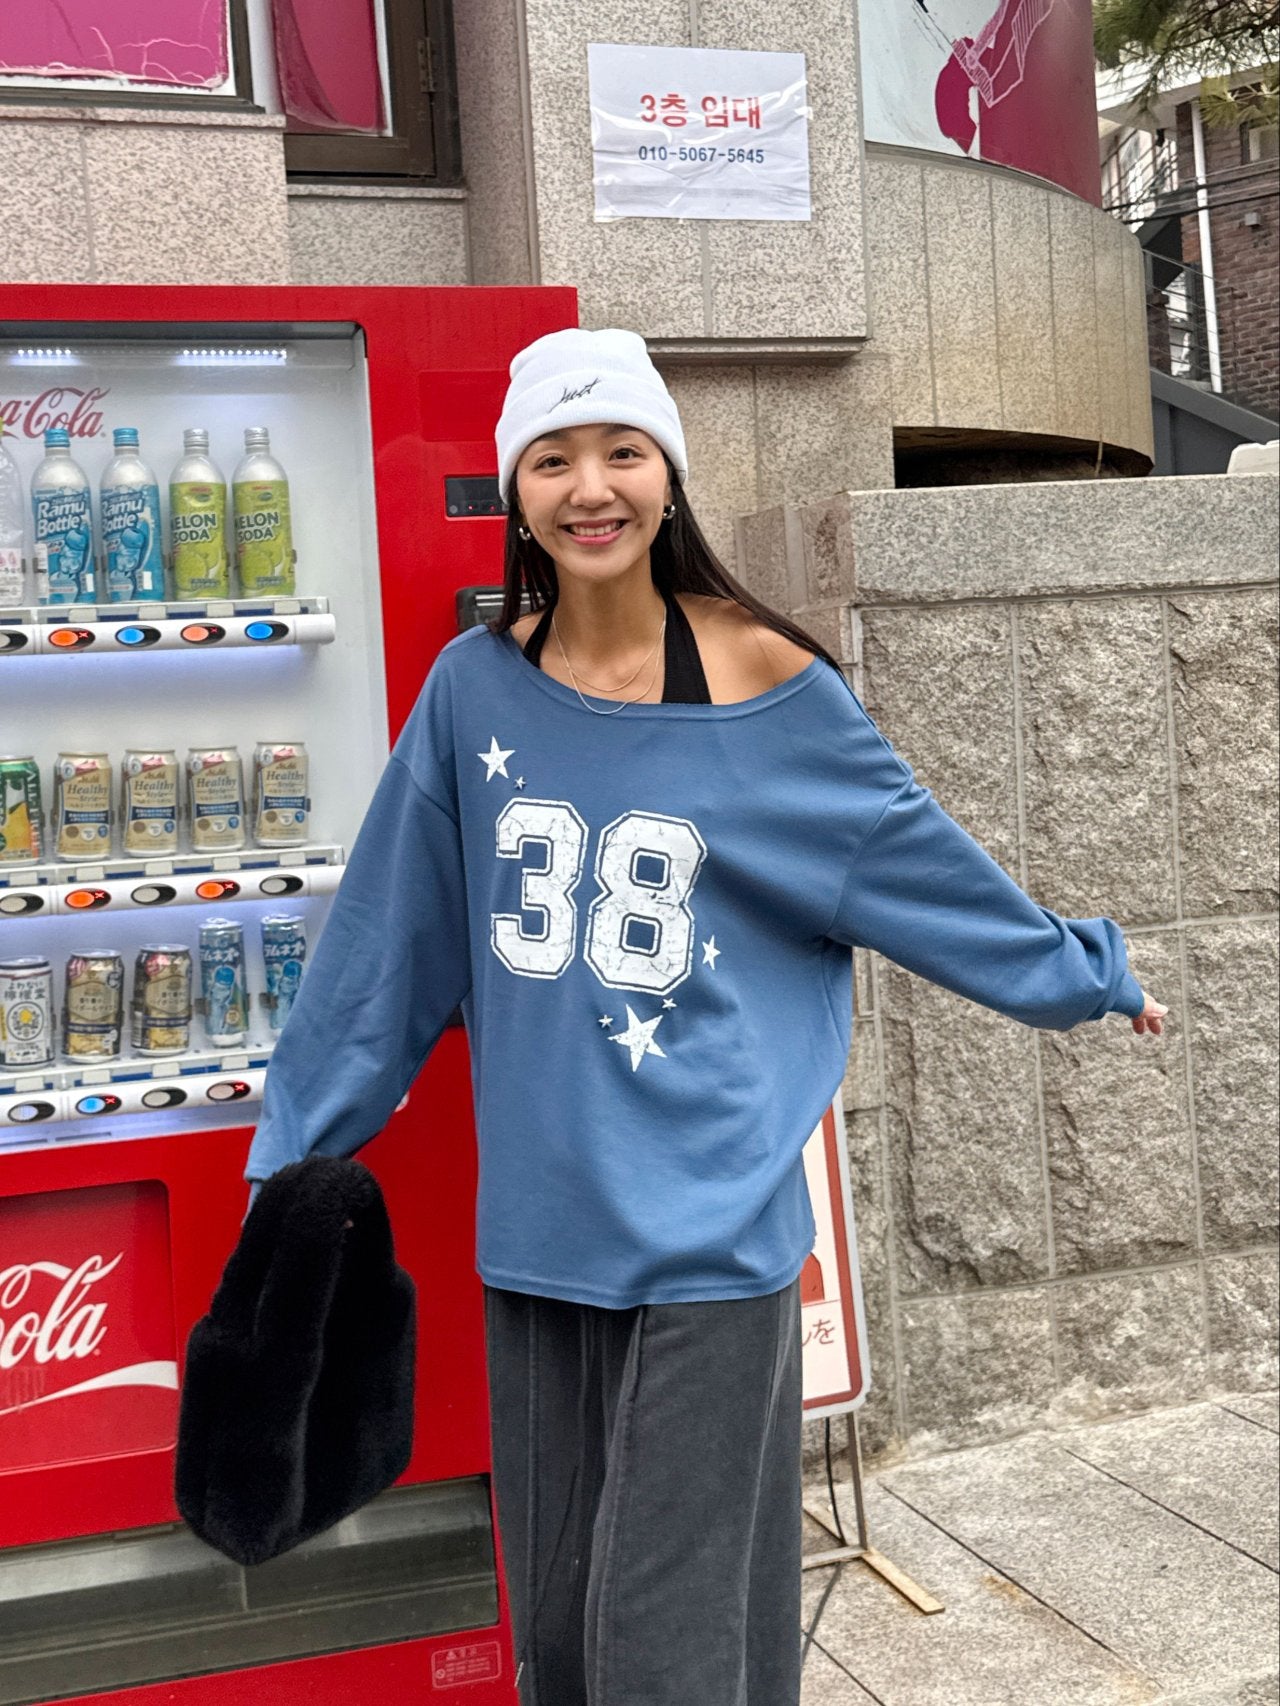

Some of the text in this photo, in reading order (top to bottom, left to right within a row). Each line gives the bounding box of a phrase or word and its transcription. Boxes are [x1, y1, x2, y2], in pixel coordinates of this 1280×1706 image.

[640, 93, 763, 129] 3층 임대
[638, 145, 765, 164] 010-5067-5645
[38, 500, 85, 519] Ramu
[37, 514, 80, 538] Bottle
[238, 527, 273, 542] SODA
[196, 776, 236, 789] Healthy
[266, 770, 304, 784] Healthy
[67, 784, 107, 797] Healthy
[134, 780, 174, 793] Healthy
[490, 796, 709, 996] 38
